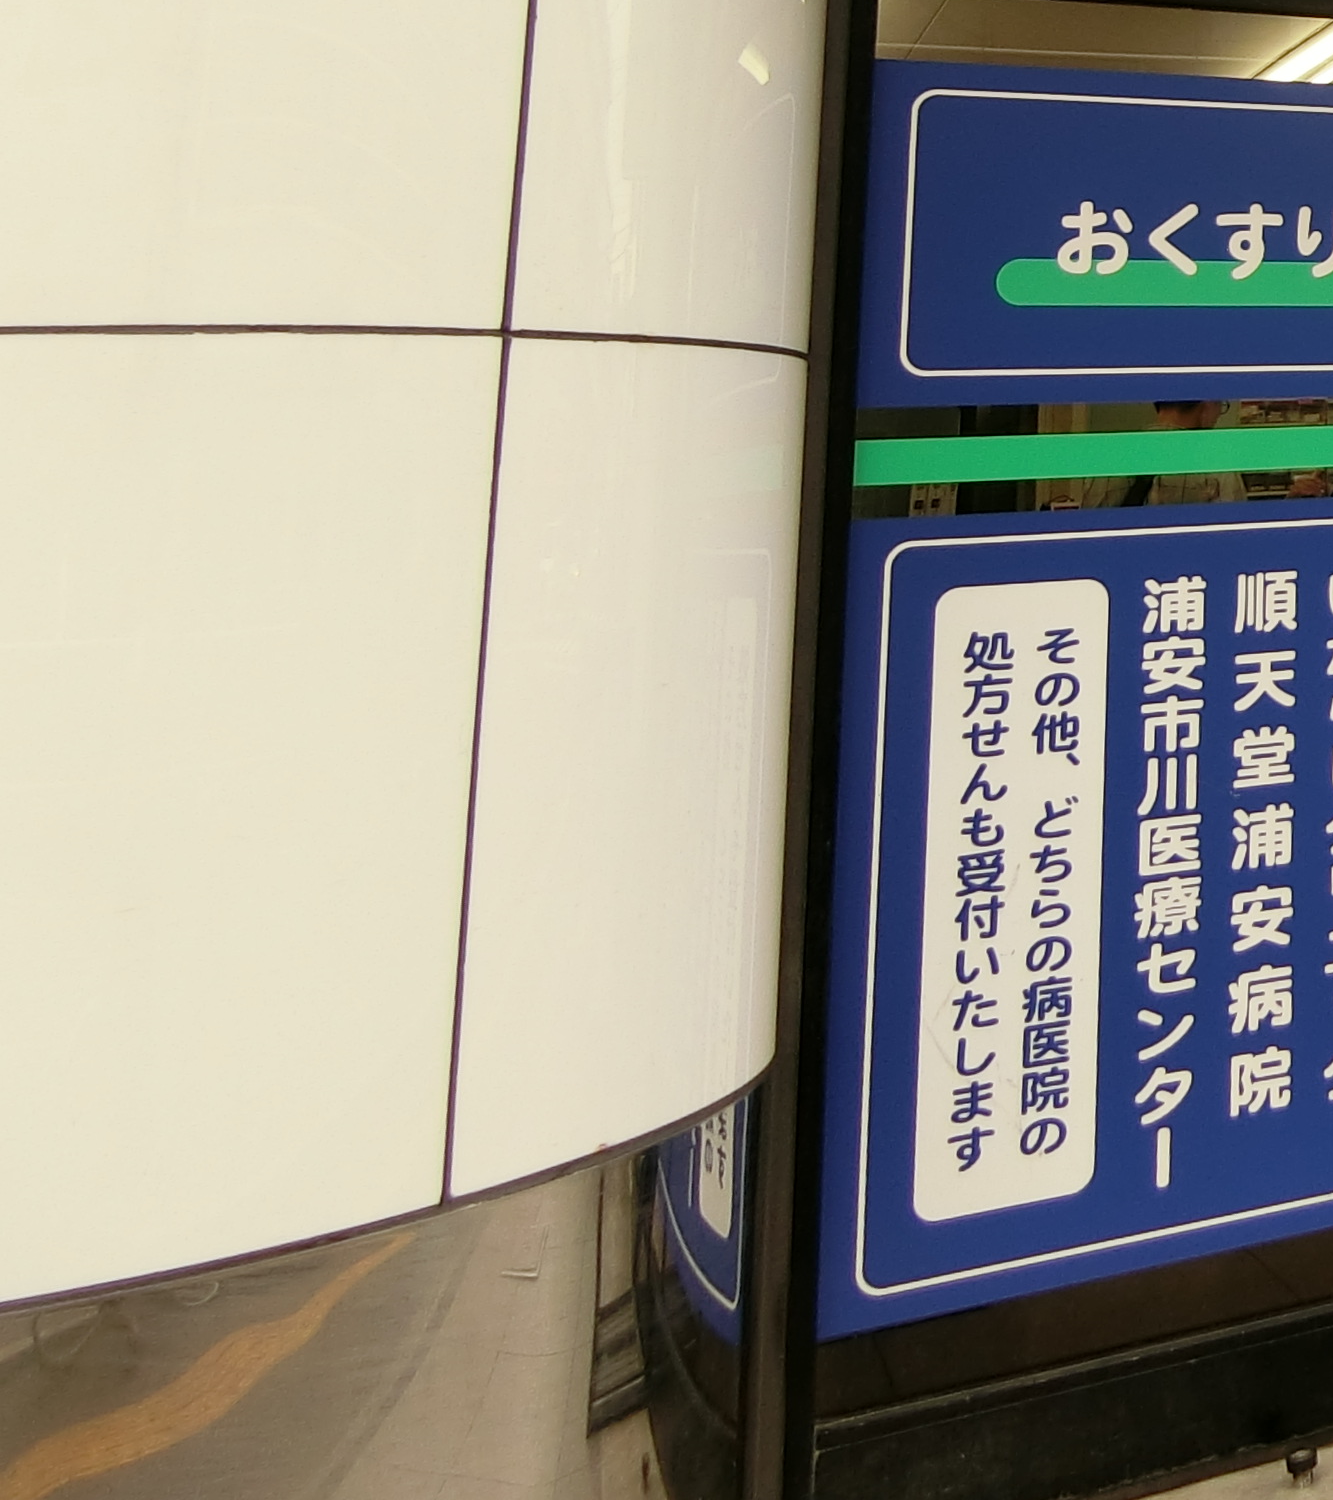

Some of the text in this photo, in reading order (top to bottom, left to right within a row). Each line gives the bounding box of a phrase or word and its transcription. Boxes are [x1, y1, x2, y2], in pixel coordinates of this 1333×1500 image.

[946, 630, 1015, 1173] 処方せんも受付いたします
[1018, 626, 1081, 1158] その他、どちらの病医院の
[1132, 574, 1208, 1190] 浦安市川医療センター
[1227, 568, 1299, 1118] 順天堂浦安病院
